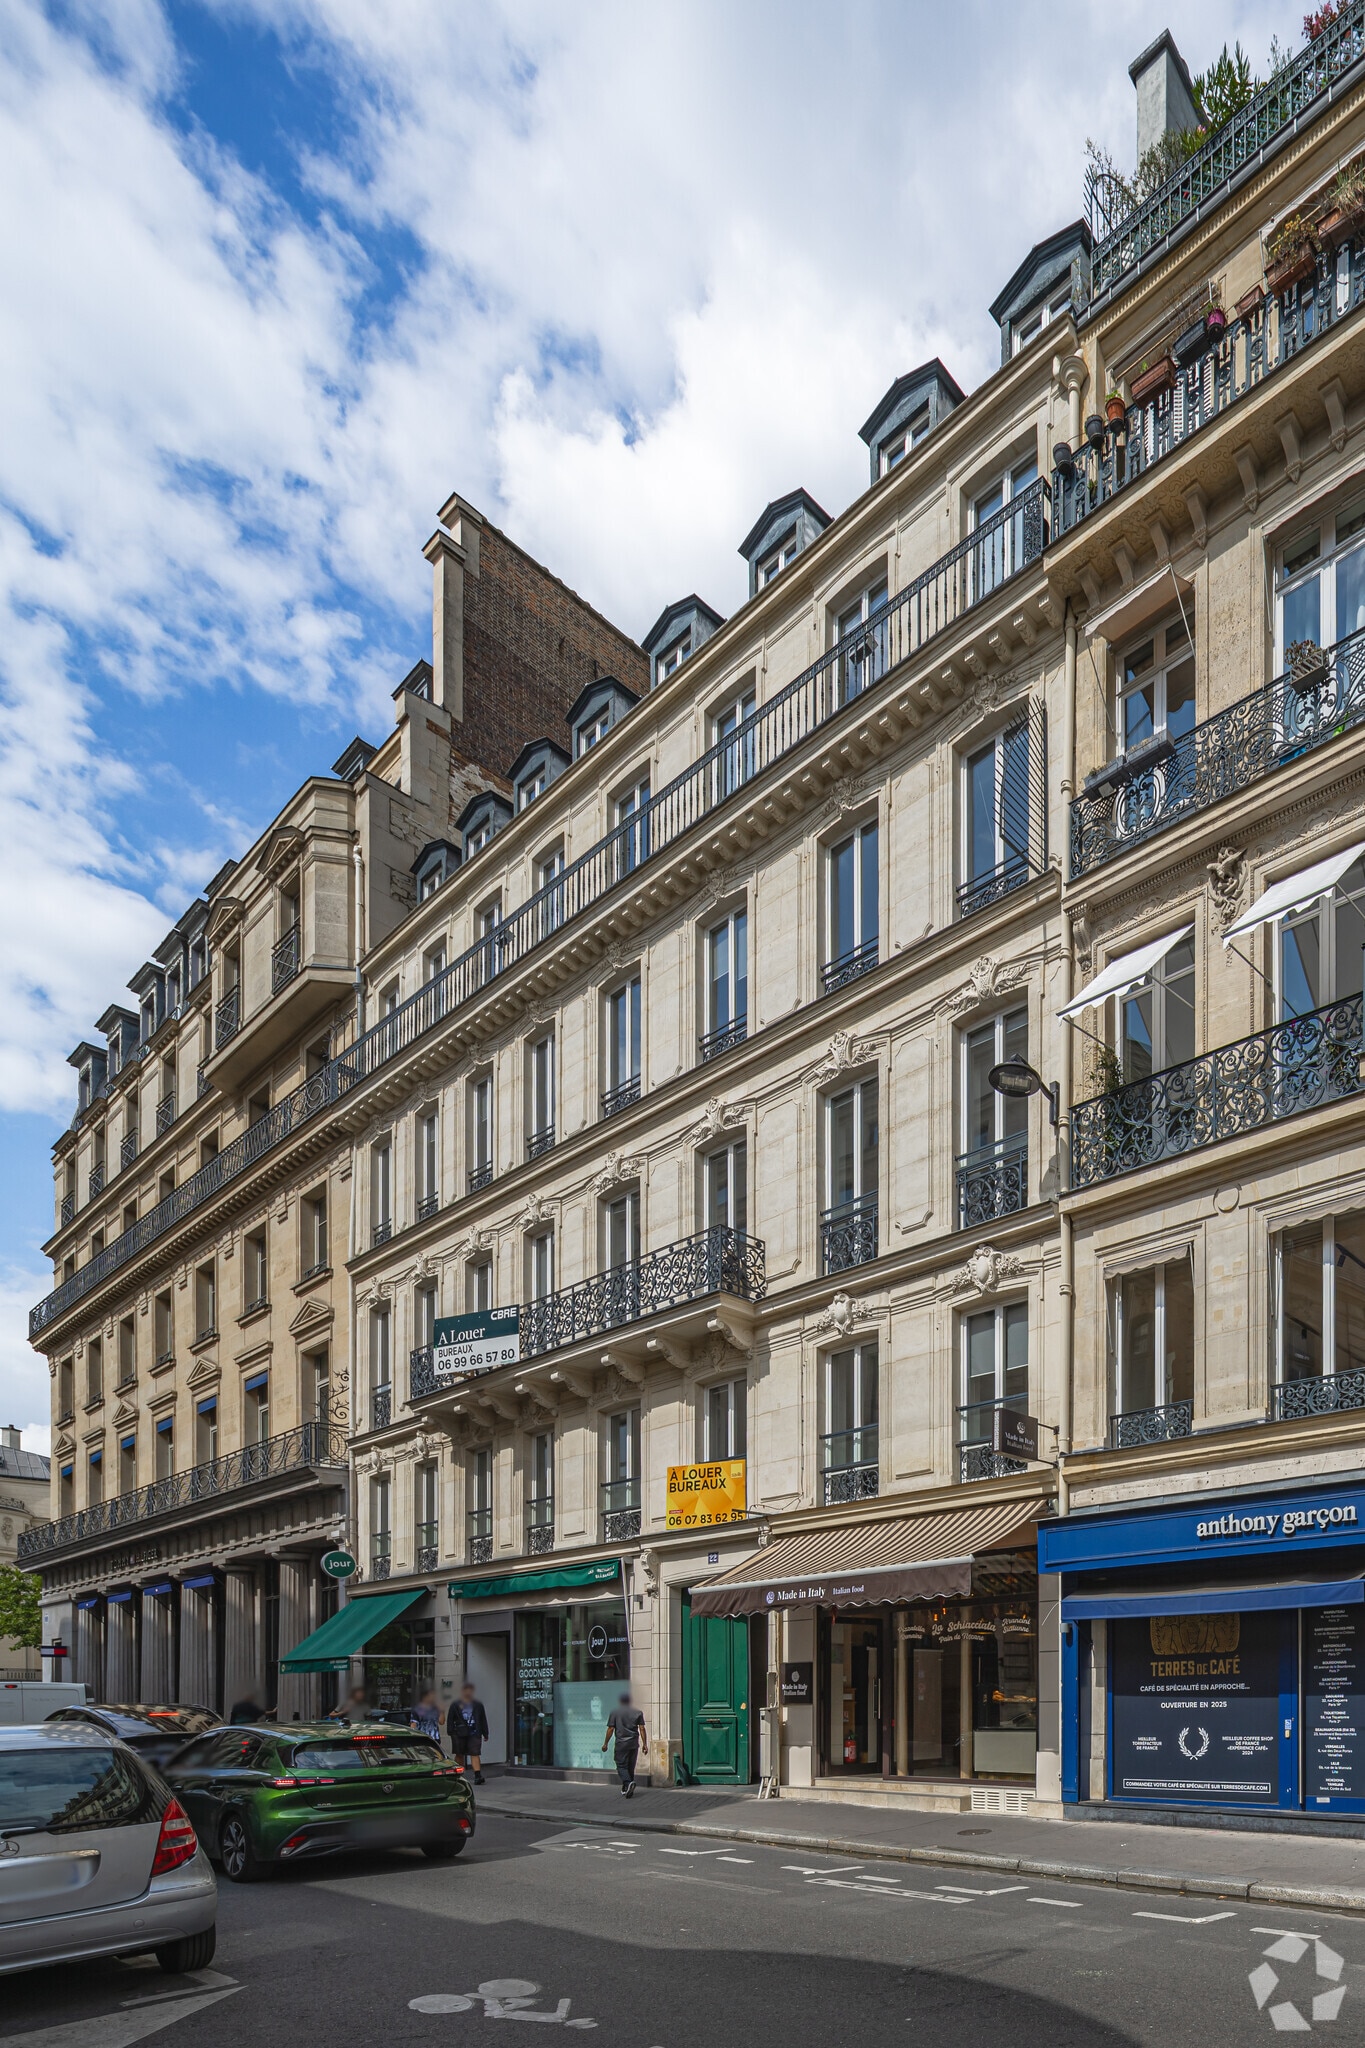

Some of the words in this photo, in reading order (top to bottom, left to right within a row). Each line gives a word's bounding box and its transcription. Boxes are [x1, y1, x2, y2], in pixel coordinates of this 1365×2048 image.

[491, 1308, 516, 1320] CBRE
[438, 1332, 448, 1345] A
[450, 1328, 485, 1343] Louer
[438, 1344, 473, 1358] BUREAUX
[438, 1359, 451, 1370] 06
[454, 1357, 466, 1368] 99
[470, 1354, 482, 1365] 66
[486, 1352, 498, 1362] 57
[501, 1348, 514, 1360] 80
[670, 1468, 678, 1481] À
[682, 1467, 722, 1480] LOUER
[670, 1478, 726, 1492] BUREAUX
[669, 1516, 681, 1525] 06
[685, 1515, 697, 1524] 07
[700, 1514, 712, 1524] 83
[716, 1513, 727, 1522] 62
[731, 1512, 743, 1521] 95
[1196, 1512, 1280, 1536] anthony
[1282, 1505, 1357, 1534] garçon
[709, 1554, 717, 1562] 22
[329, 1560, 351, 1569] jour
[777, 1591, 797, 1600] Made
[799, 1589, 806, 1598] in
[808, 1587, 825, 1598] Italy
[932, 1624, 943, 1636] La
[592, 1637, 604, 1648] jour
[520, 1658, 539, 1667] TASTE
[540, 1657, 552, 1666] THE
[1151, 1660, 1195, 1677] TERRES
[1196, 1663, 1208, 1675] DE
[1210, 1655, 1240, 1675] CAFÉ
[519, 1668, 554, 1678] GOODNESS
[523, 1680, 536, 1688] FEEL
[538, 1679, 550, 1688] THE
[524, 1690, 548, 1699] ENERGY
